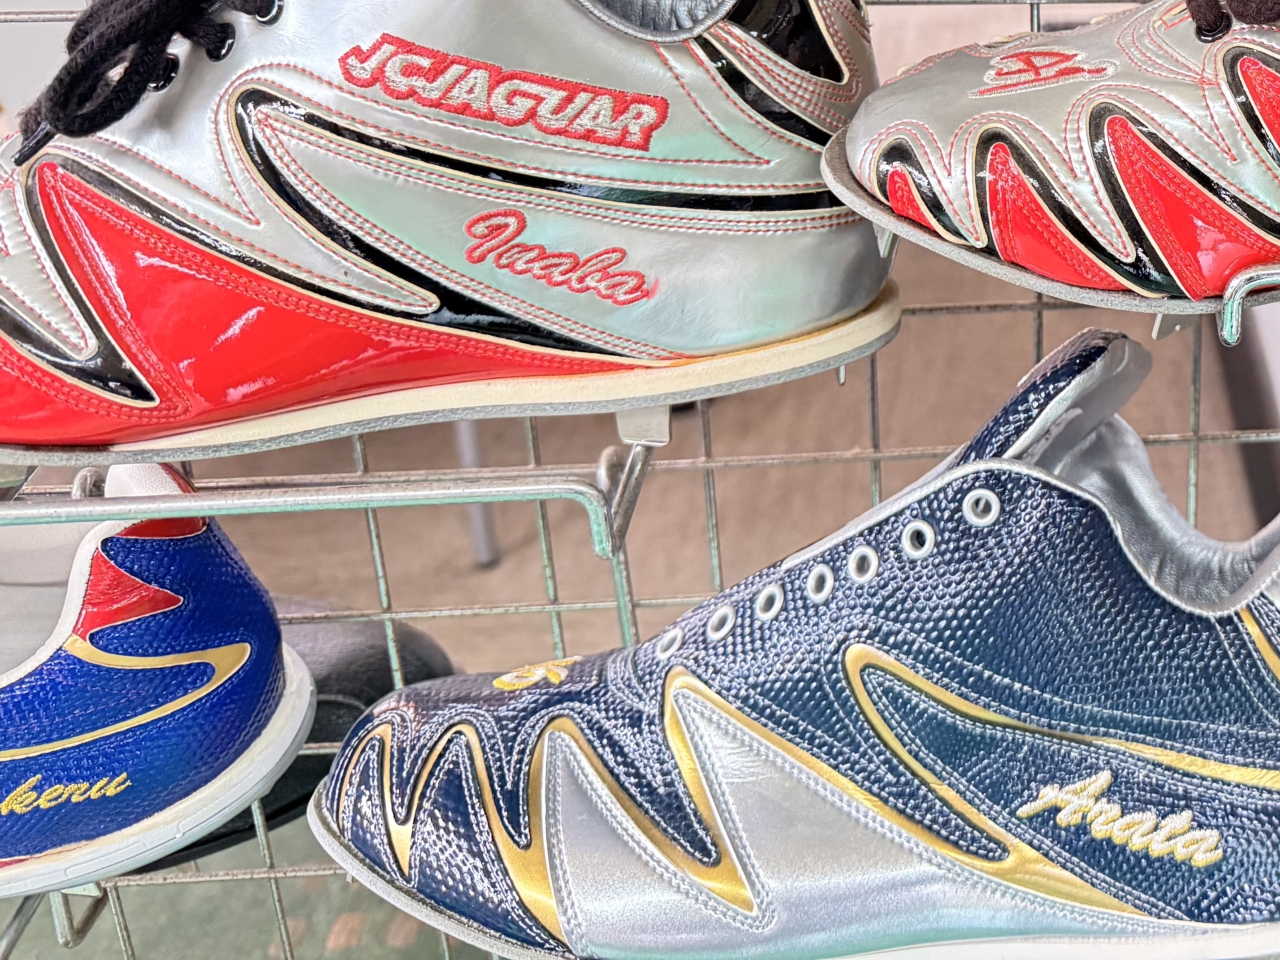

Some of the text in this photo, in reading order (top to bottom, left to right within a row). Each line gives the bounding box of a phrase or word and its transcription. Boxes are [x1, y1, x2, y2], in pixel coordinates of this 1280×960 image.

[340, 35, 668, 150] JCJAGUAR
[465, 208, 652, 306] Inaba
[1016, 769, 1223, 868] Arata
